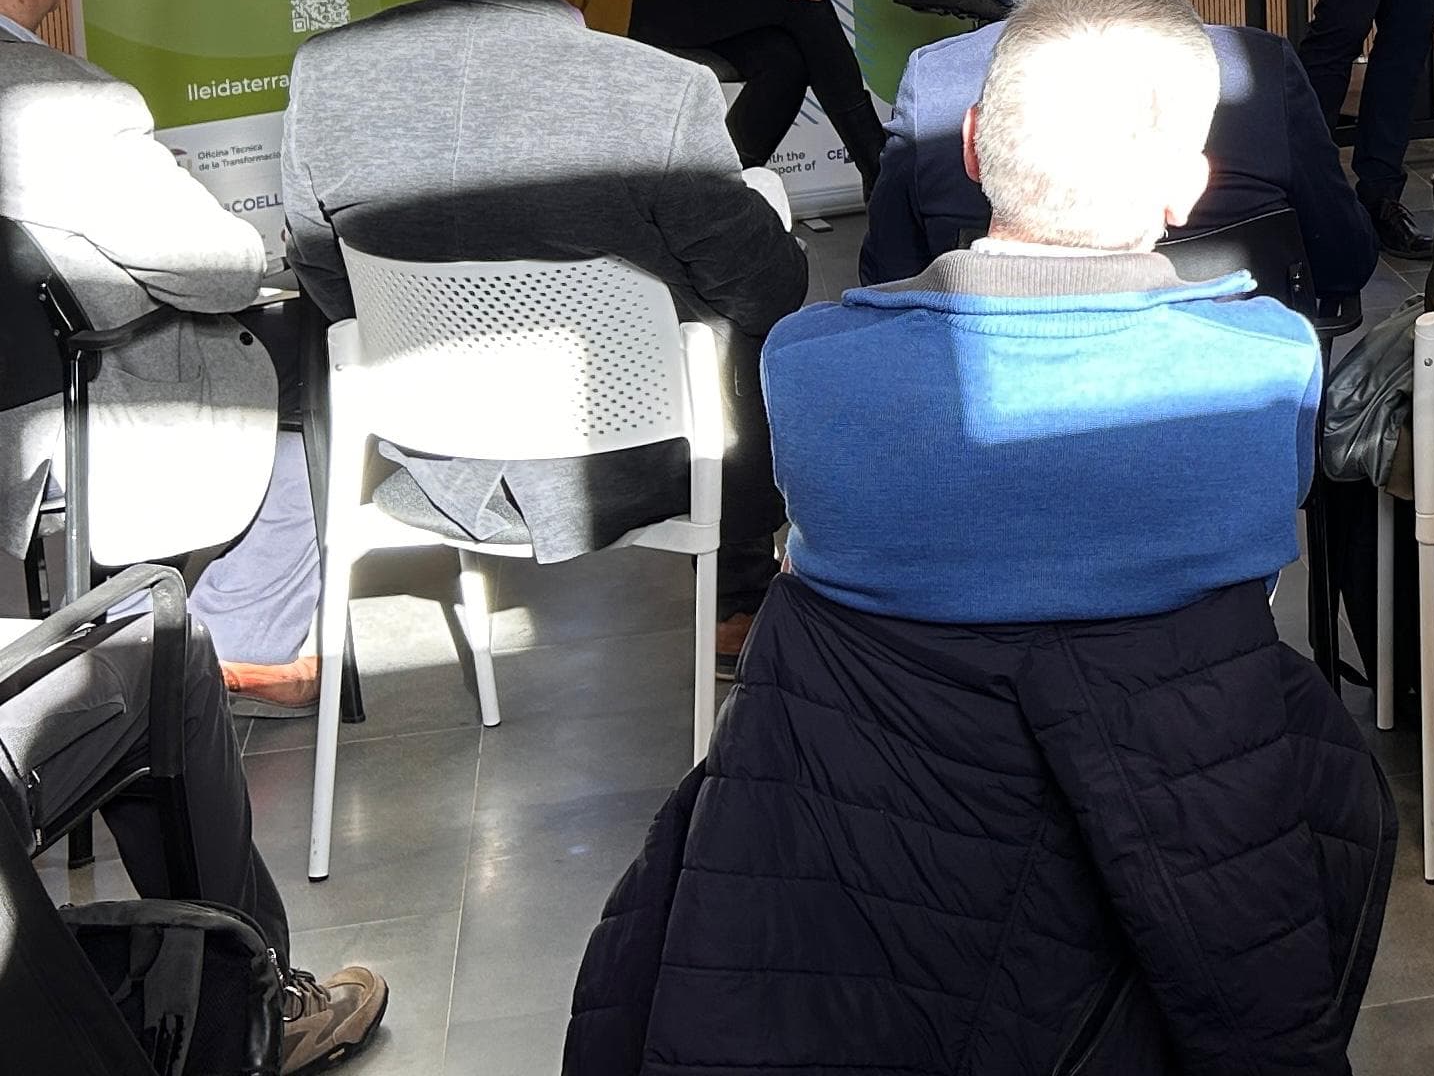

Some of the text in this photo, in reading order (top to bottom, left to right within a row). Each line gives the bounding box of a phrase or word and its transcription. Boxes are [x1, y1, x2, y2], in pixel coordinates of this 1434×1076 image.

[197, 149, 229, 160] Oficina
[787, 151, 805, 162] the
[199, 163, 210, 171] de
[805, 160, 816, 171] of
